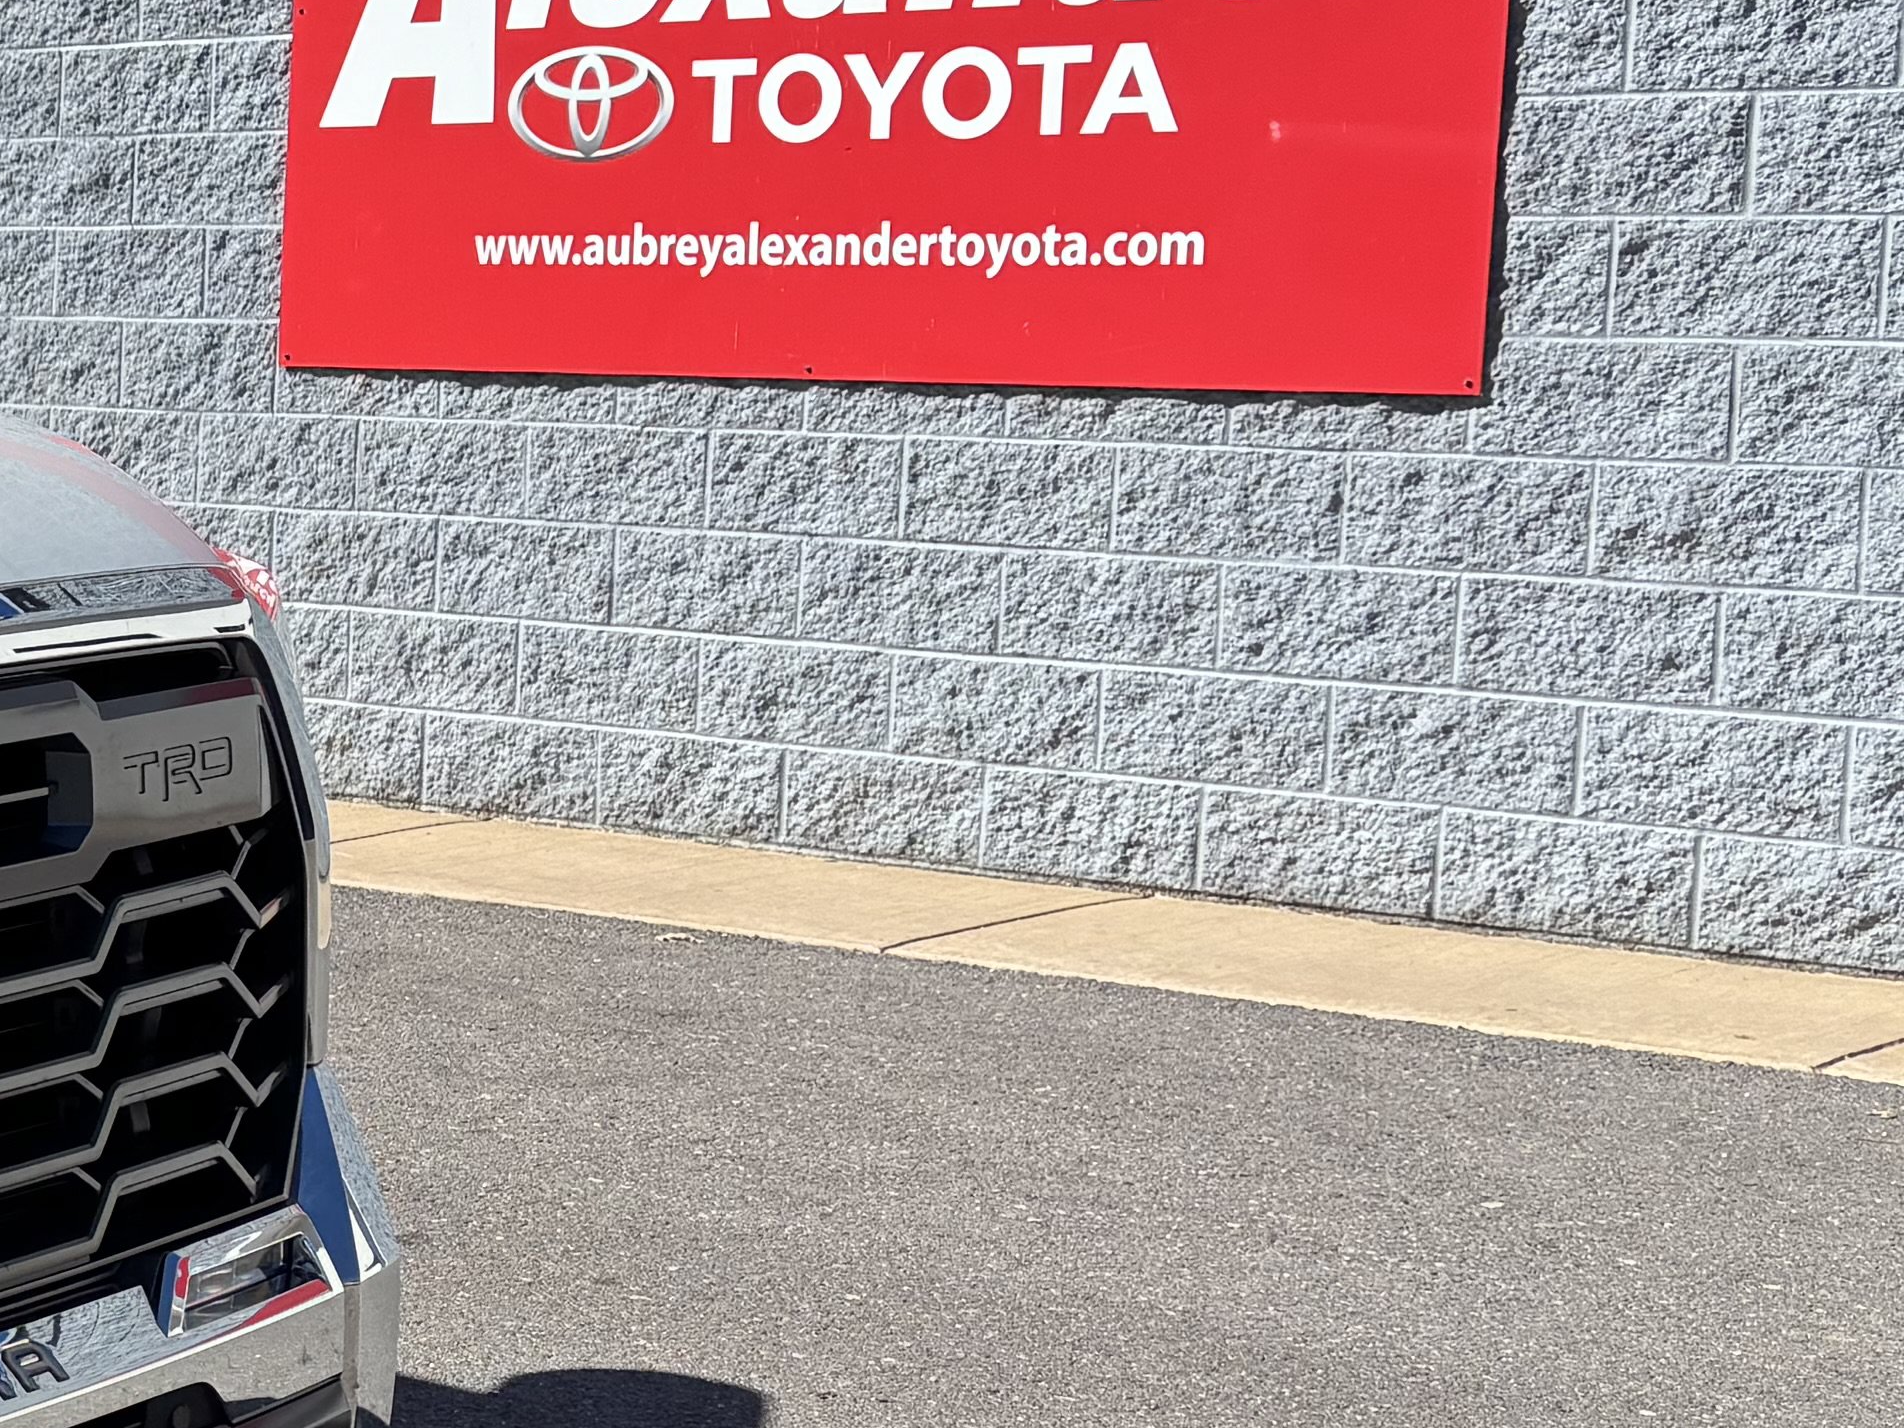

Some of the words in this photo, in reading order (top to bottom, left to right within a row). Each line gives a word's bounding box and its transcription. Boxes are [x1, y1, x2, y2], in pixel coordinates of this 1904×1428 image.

[691, 42, 1179, 144] TOYOTA
[474, 220, 1205, 279] www.aubreyalexandertoyota.com
[122, 735, 234, 802] TRD
